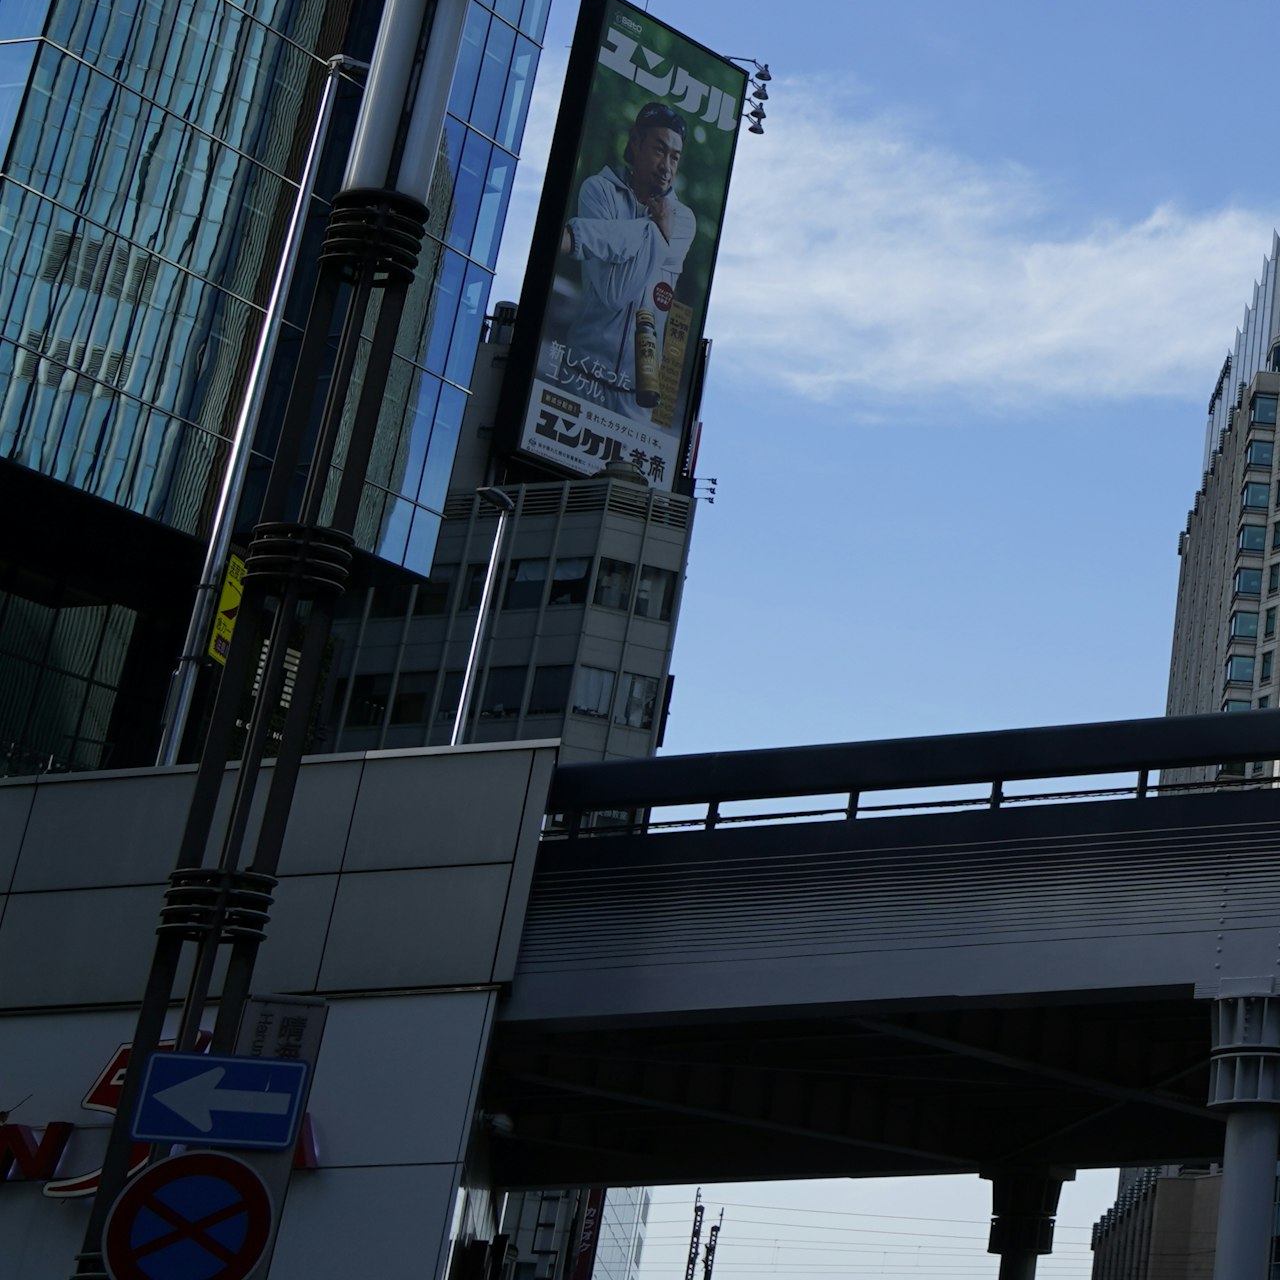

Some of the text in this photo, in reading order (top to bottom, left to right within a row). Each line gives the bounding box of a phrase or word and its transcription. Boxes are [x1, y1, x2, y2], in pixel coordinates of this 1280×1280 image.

[598, 26, 738, 132] ユンケル
[545, 364, 606, 402] ユンケル。
[548, 340, 633, 392] 新しくなった
[535, 409, 625, 462] ユンケル
